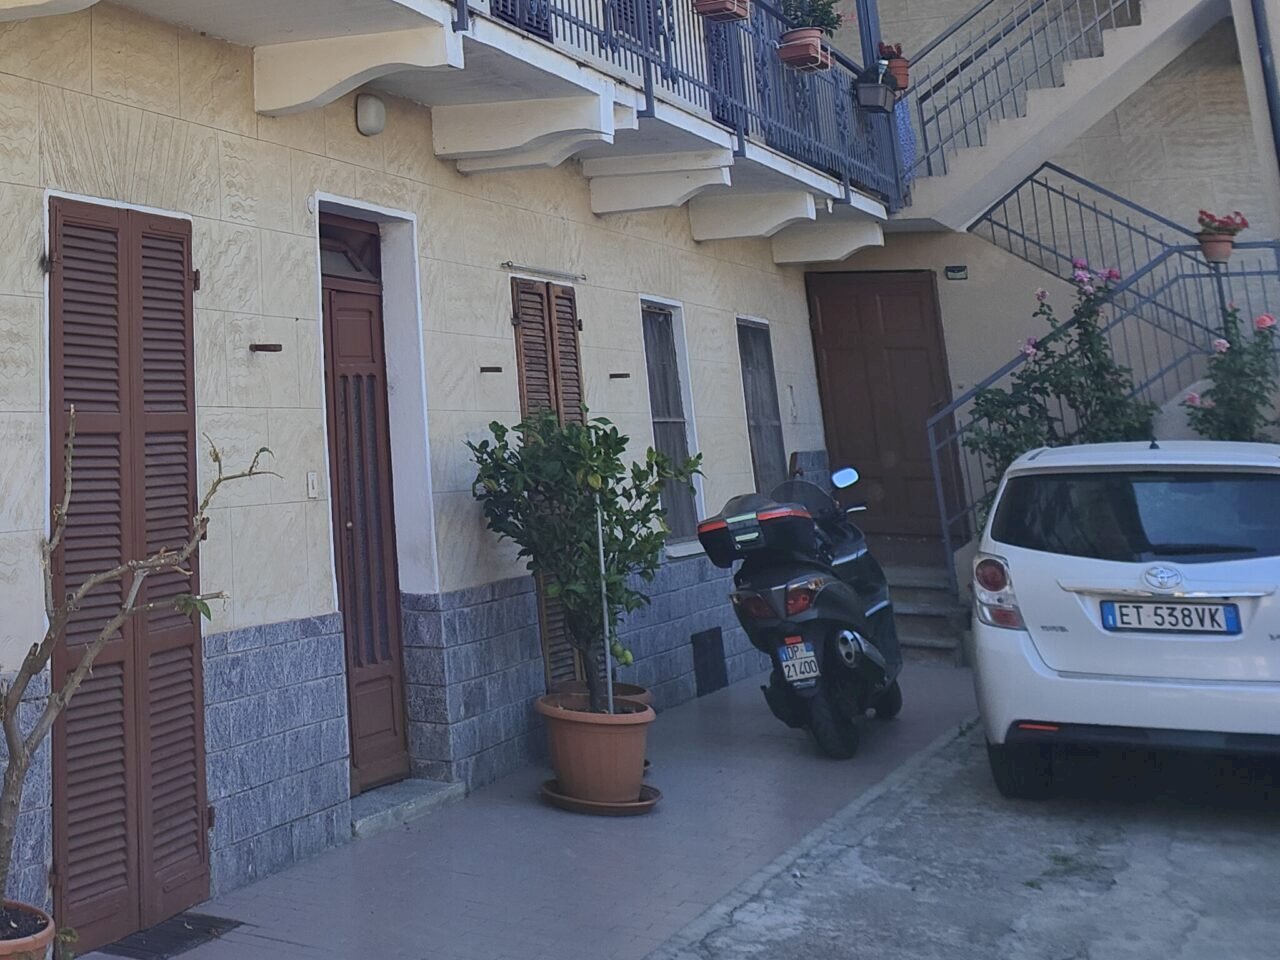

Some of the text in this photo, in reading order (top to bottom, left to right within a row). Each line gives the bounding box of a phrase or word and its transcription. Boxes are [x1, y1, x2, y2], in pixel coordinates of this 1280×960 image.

[1118, 605, 1144, 626] ET
[1153, 606, 1223, 629] 538VK
[784, 659, 818, 679] 21400
